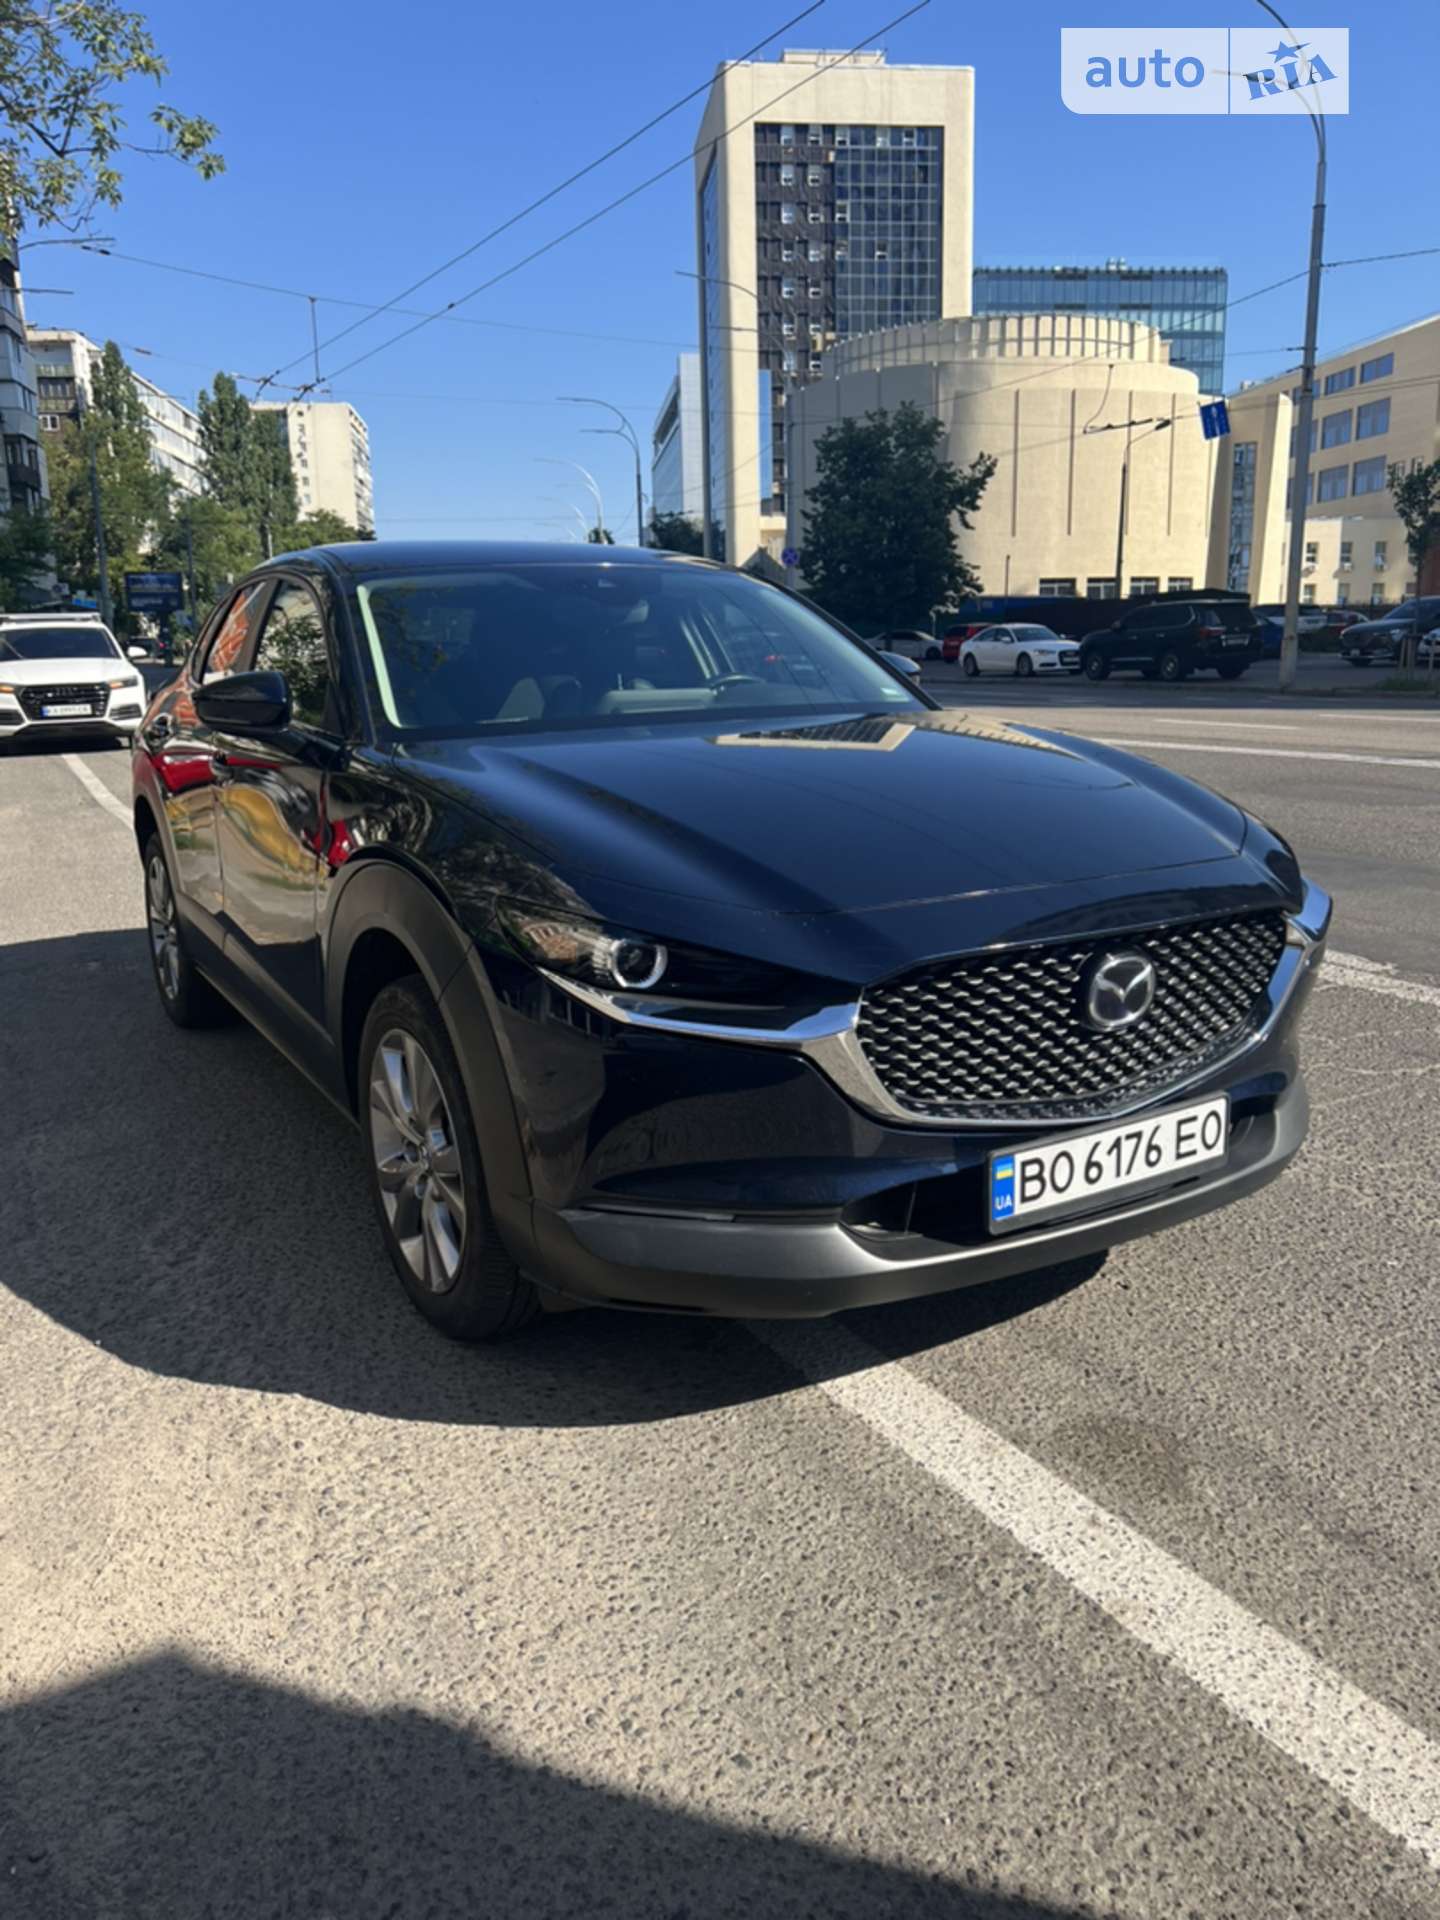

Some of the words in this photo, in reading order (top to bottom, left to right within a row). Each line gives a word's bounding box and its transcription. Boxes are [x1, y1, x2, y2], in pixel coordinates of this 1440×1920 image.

[1019, 1150, 1075, 1204] BO
[1083, 1124, 1162, 1185] 6176
[1174, 1110, 1222, 1160] EO
[995, 1194, 1013, 1210] UA
